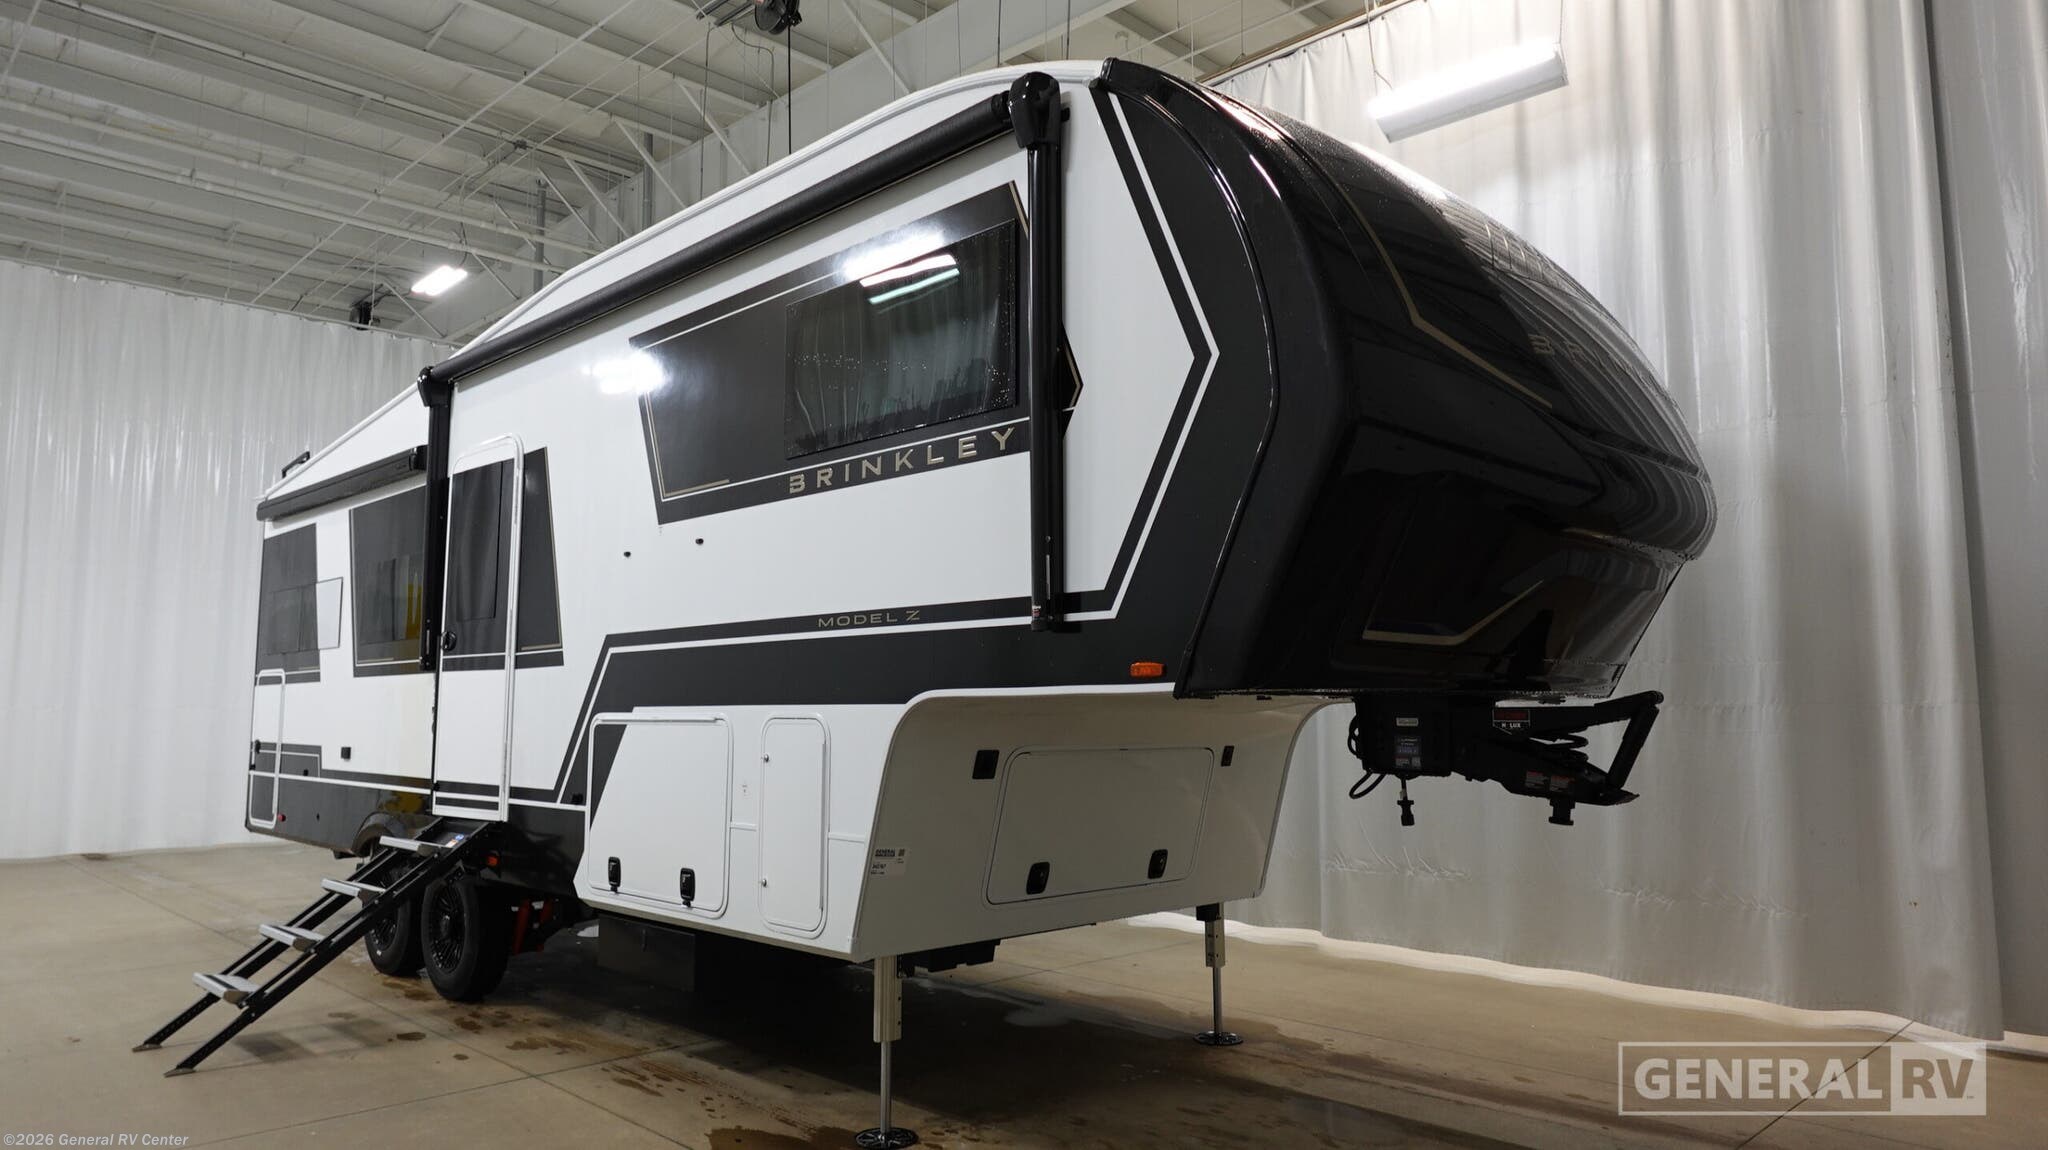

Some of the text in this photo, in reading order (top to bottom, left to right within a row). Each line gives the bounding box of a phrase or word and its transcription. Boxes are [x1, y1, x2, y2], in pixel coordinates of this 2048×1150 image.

[789, 426, 1015, 494] BRINKLEY
[818, 610, 921, 628] MODEL Z
